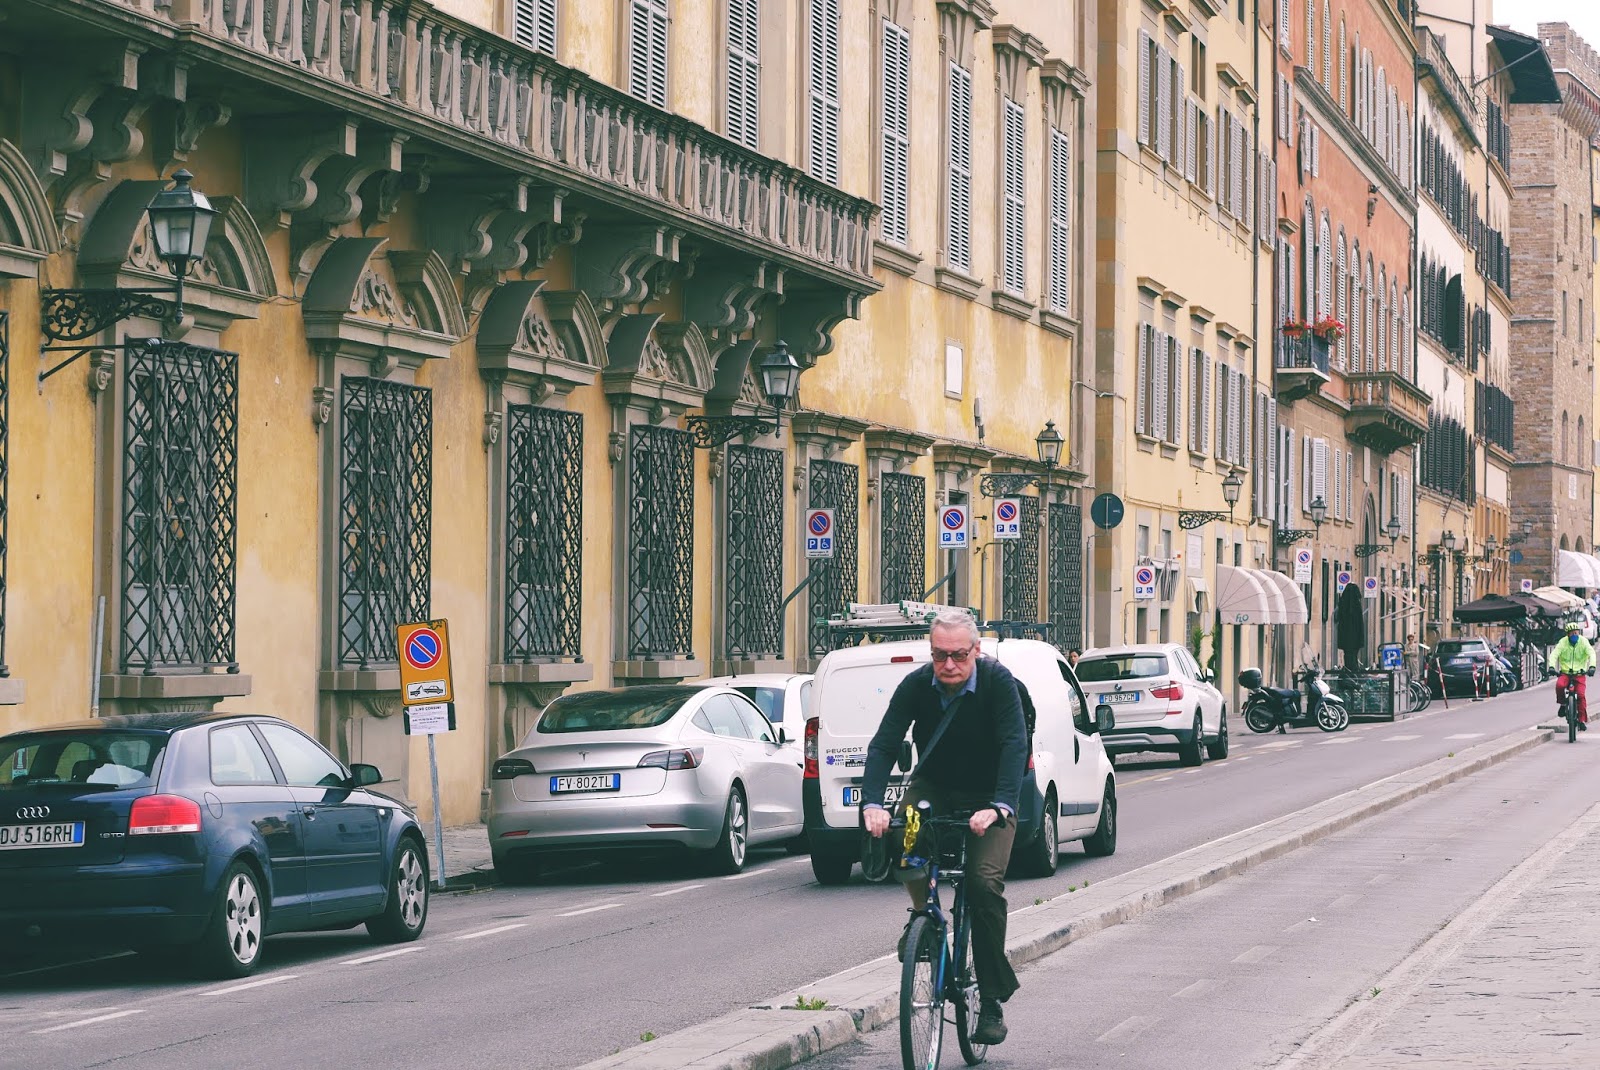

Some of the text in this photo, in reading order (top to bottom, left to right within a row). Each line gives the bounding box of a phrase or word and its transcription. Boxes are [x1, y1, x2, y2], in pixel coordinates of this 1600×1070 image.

[826, 746, 863, 754] PEUGEOT
[558, 777, 573, 790] FV
[576, 775, 612, 789] 802TL
[0, 824, 73, 844] DJ 516RH
